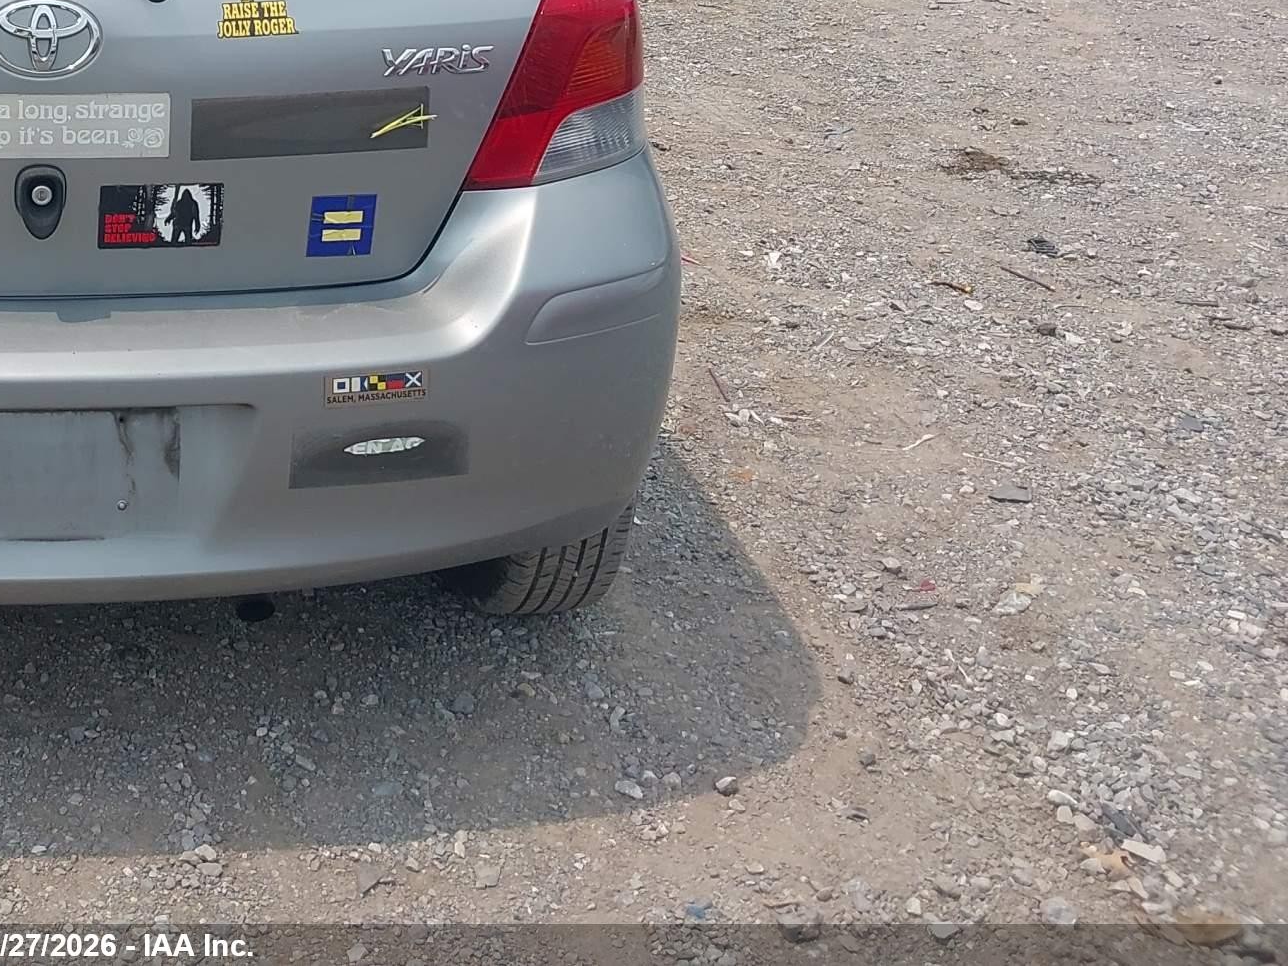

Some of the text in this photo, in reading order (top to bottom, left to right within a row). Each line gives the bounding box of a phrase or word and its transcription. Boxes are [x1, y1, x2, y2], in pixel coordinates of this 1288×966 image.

[223, 1, 287, 20] RAISE THE
[218, 18, 296, 38] JOLLY ROGER
[17, 100, 72, 124] long,
[75, 101, 165, 123] strange
[19, 126, 53, 145] it's
[62, 126, 119, 145] been
[104, 224, 132, 233] STOP
[326, 388, 426, 404] SALEM, MASSACHUSETTS
